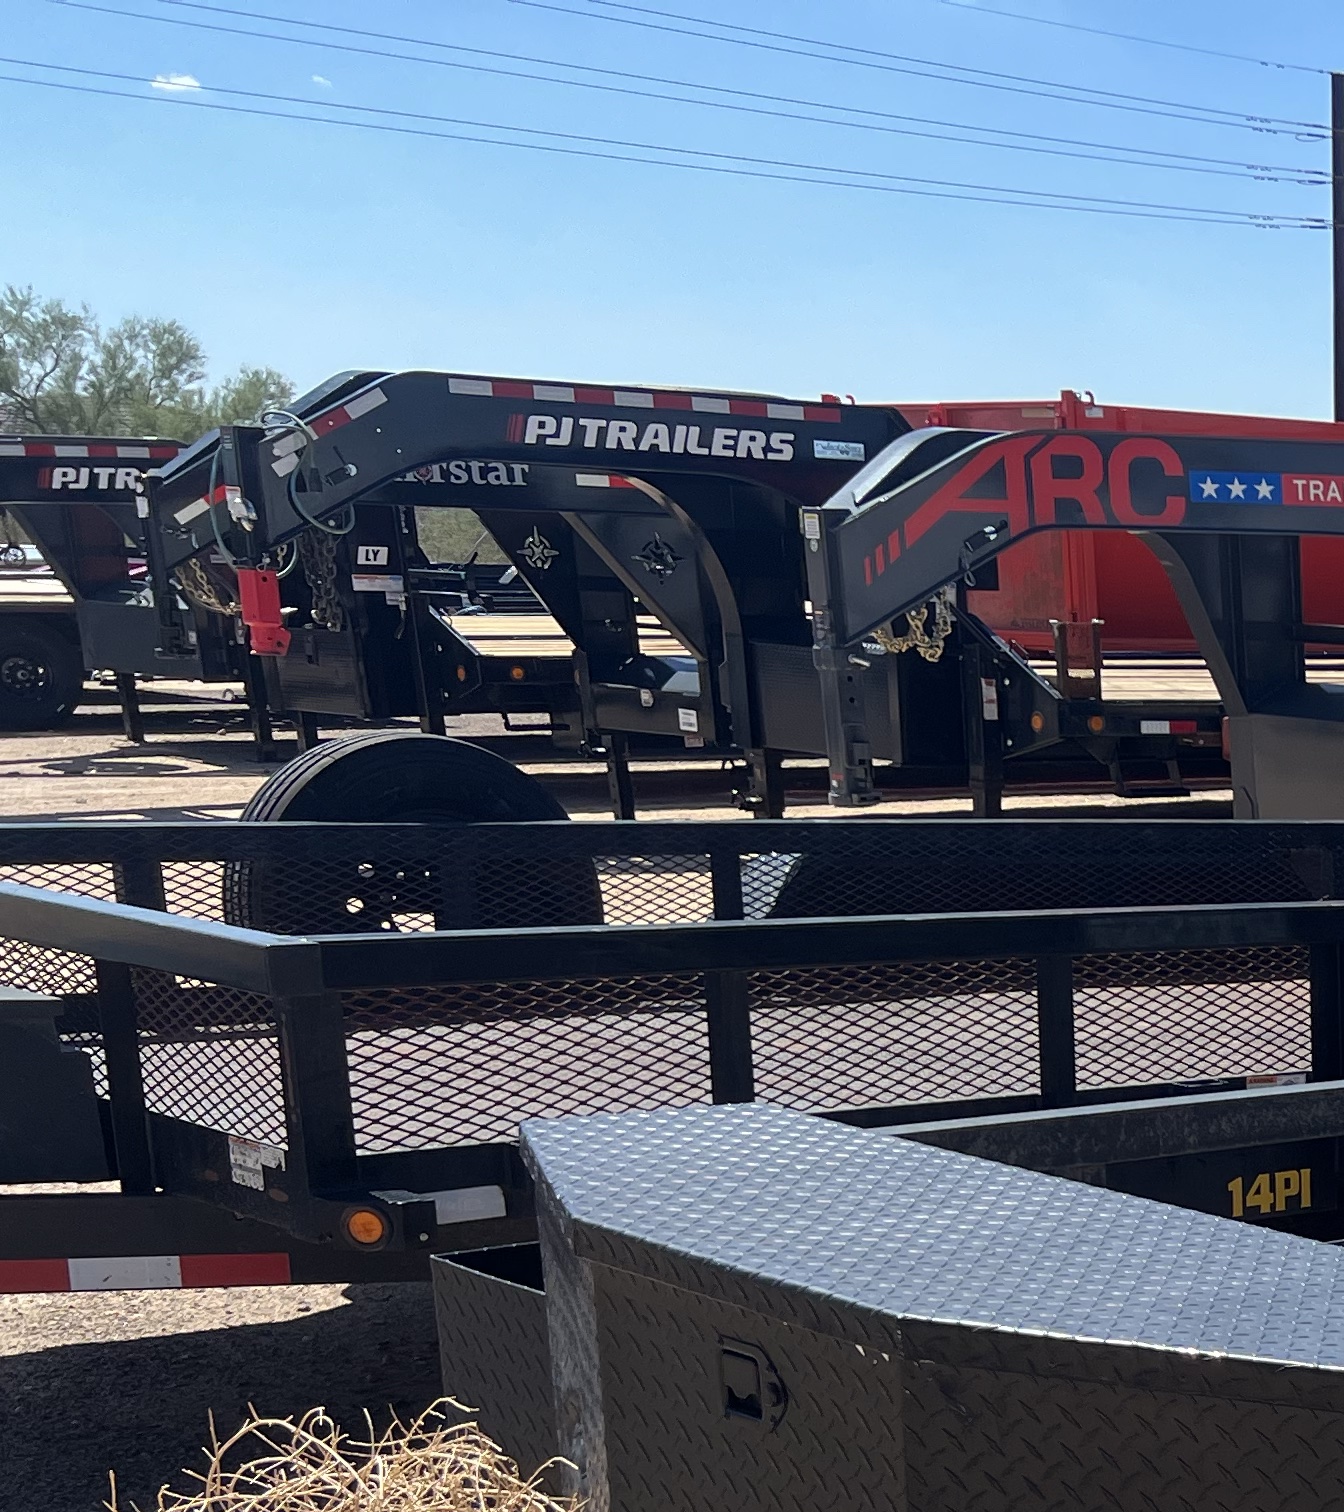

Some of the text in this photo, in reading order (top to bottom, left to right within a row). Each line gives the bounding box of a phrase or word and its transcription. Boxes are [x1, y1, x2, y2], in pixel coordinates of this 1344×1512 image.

[578, 418, 795, 461] TRAILERS
[905, 435, 1186, 549] ARC
[365, 549, 380, 562] LY
[1227, 1168, 1312, 1218] 14PI
